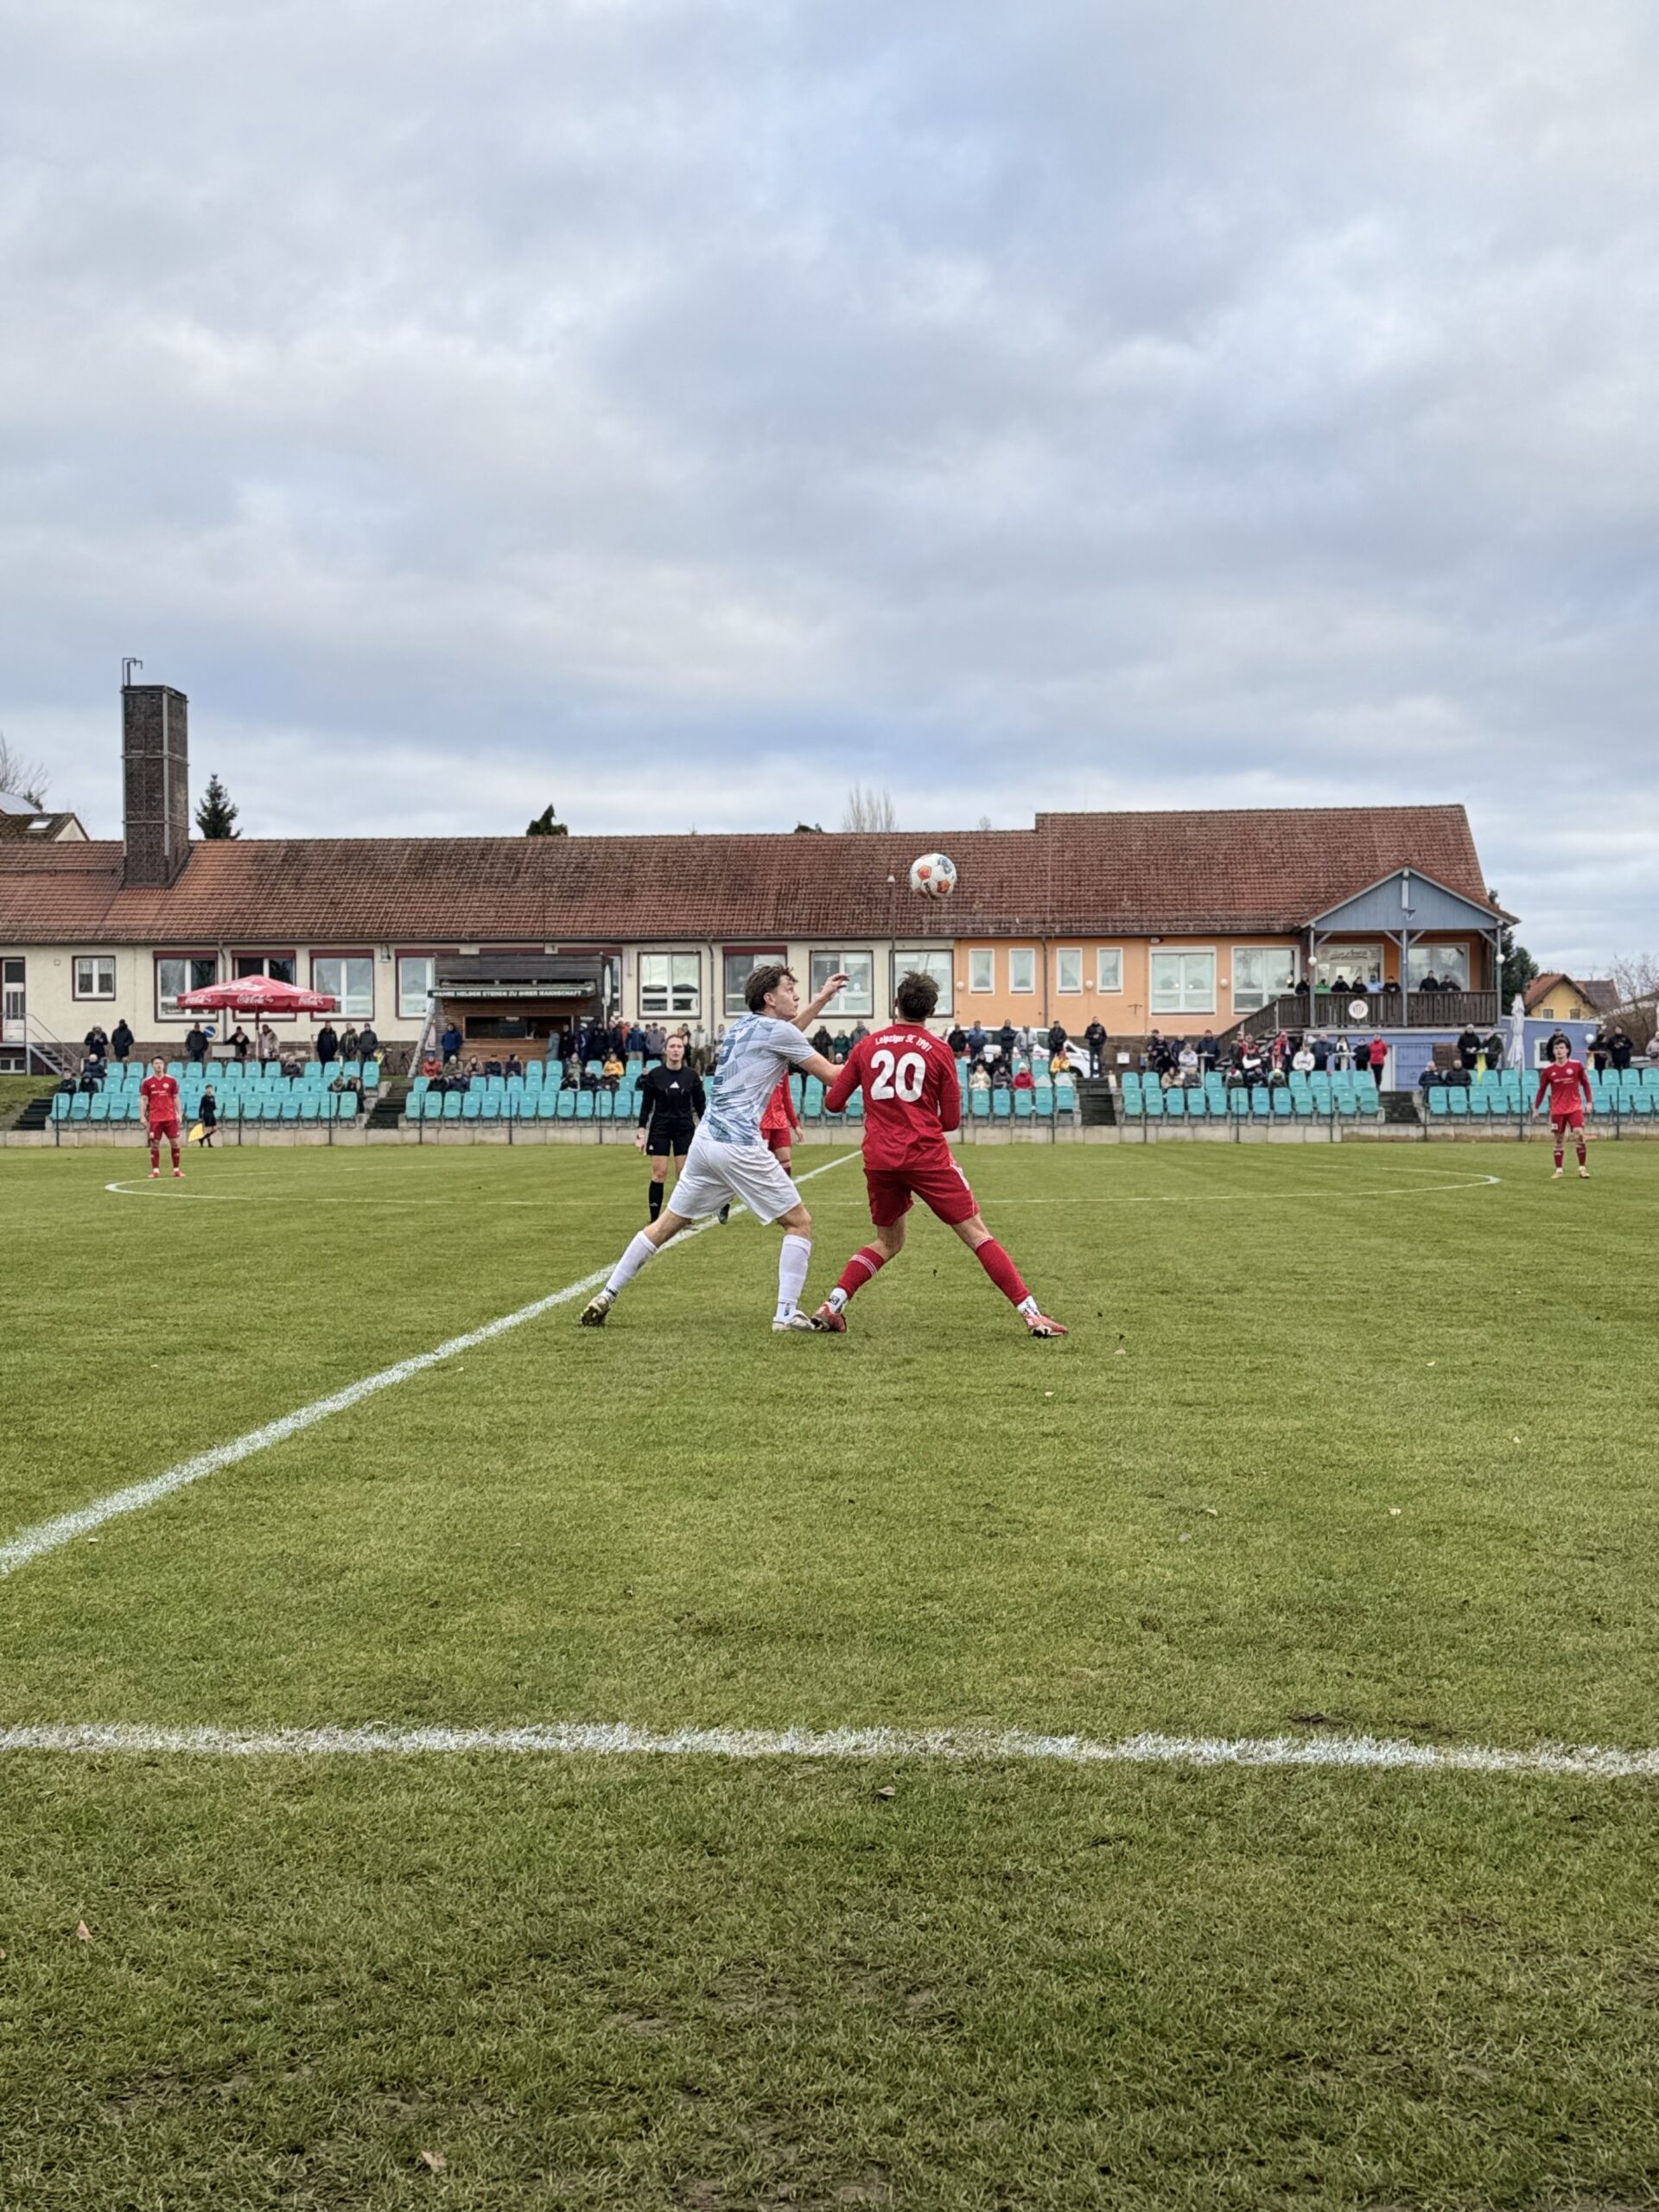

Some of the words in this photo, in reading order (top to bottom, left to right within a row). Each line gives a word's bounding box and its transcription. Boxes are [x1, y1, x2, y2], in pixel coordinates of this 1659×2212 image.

[874, 1034, 906, 1046] Leipziger
[915, 1036, 933, 1052] 1901
[870, 1049, 926, 1103] 20
